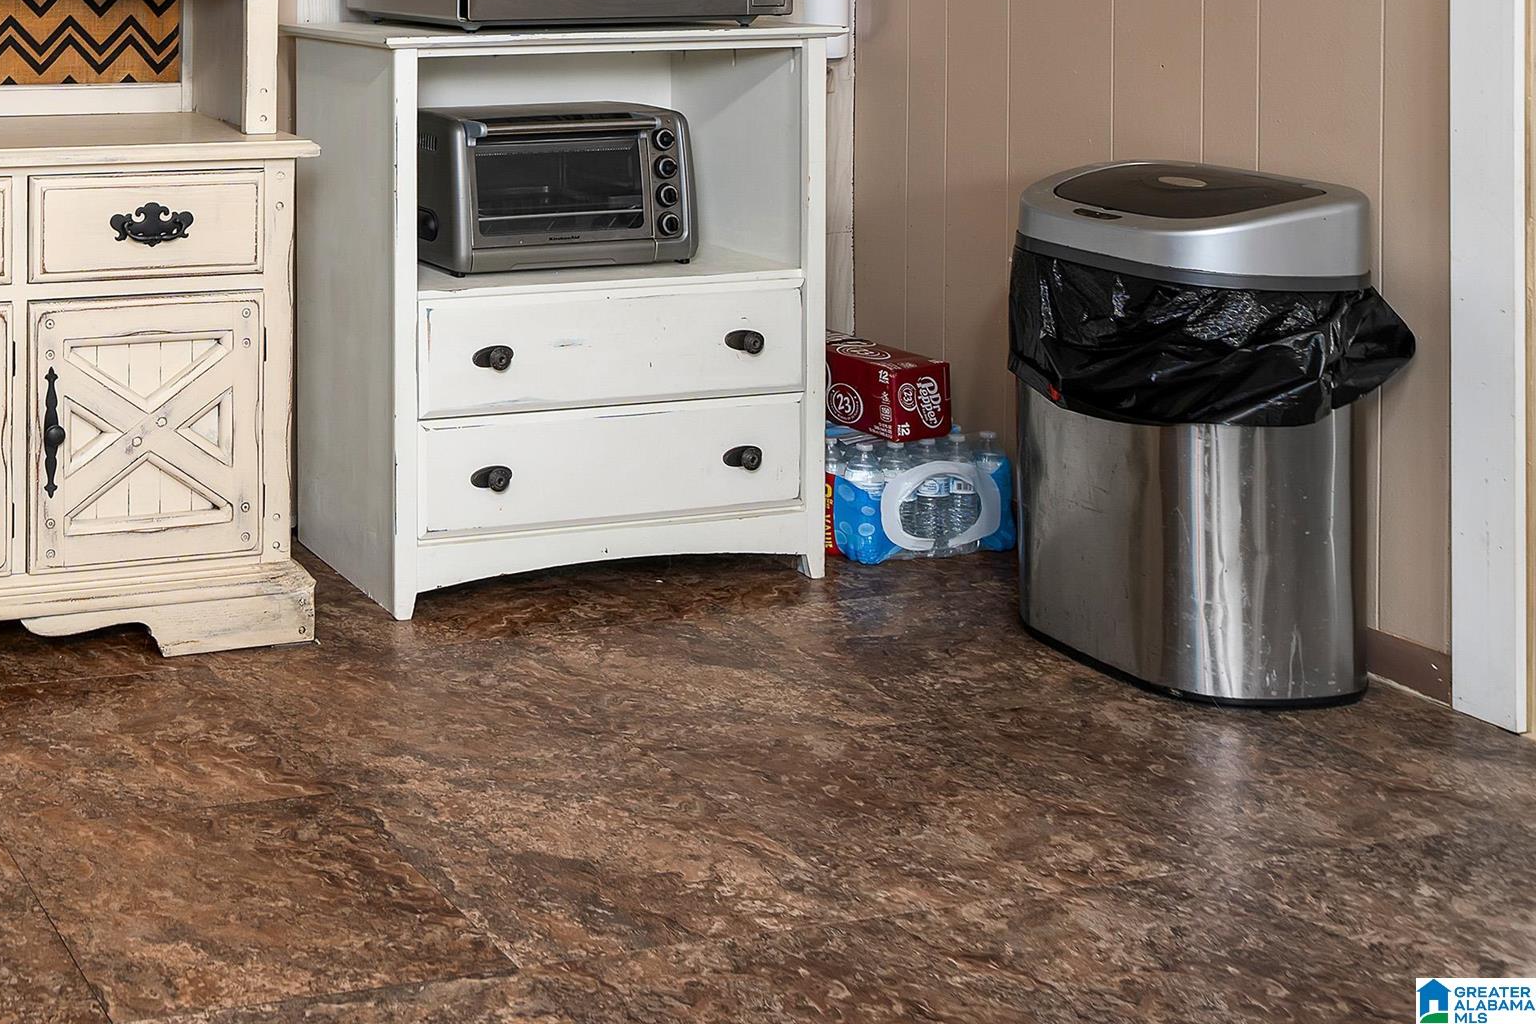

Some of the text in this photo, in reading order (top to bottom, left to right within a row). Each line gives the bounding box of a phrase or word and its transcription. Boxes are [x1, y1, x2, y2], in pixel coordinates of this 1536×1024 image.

[836, 393, 852, 414] 23
[903, 390, 912, 403] 23
[916, 376, 939, 425] Pepper
[930, 391, 942, 413] Dr
[901, 421, 911, 436] 12
